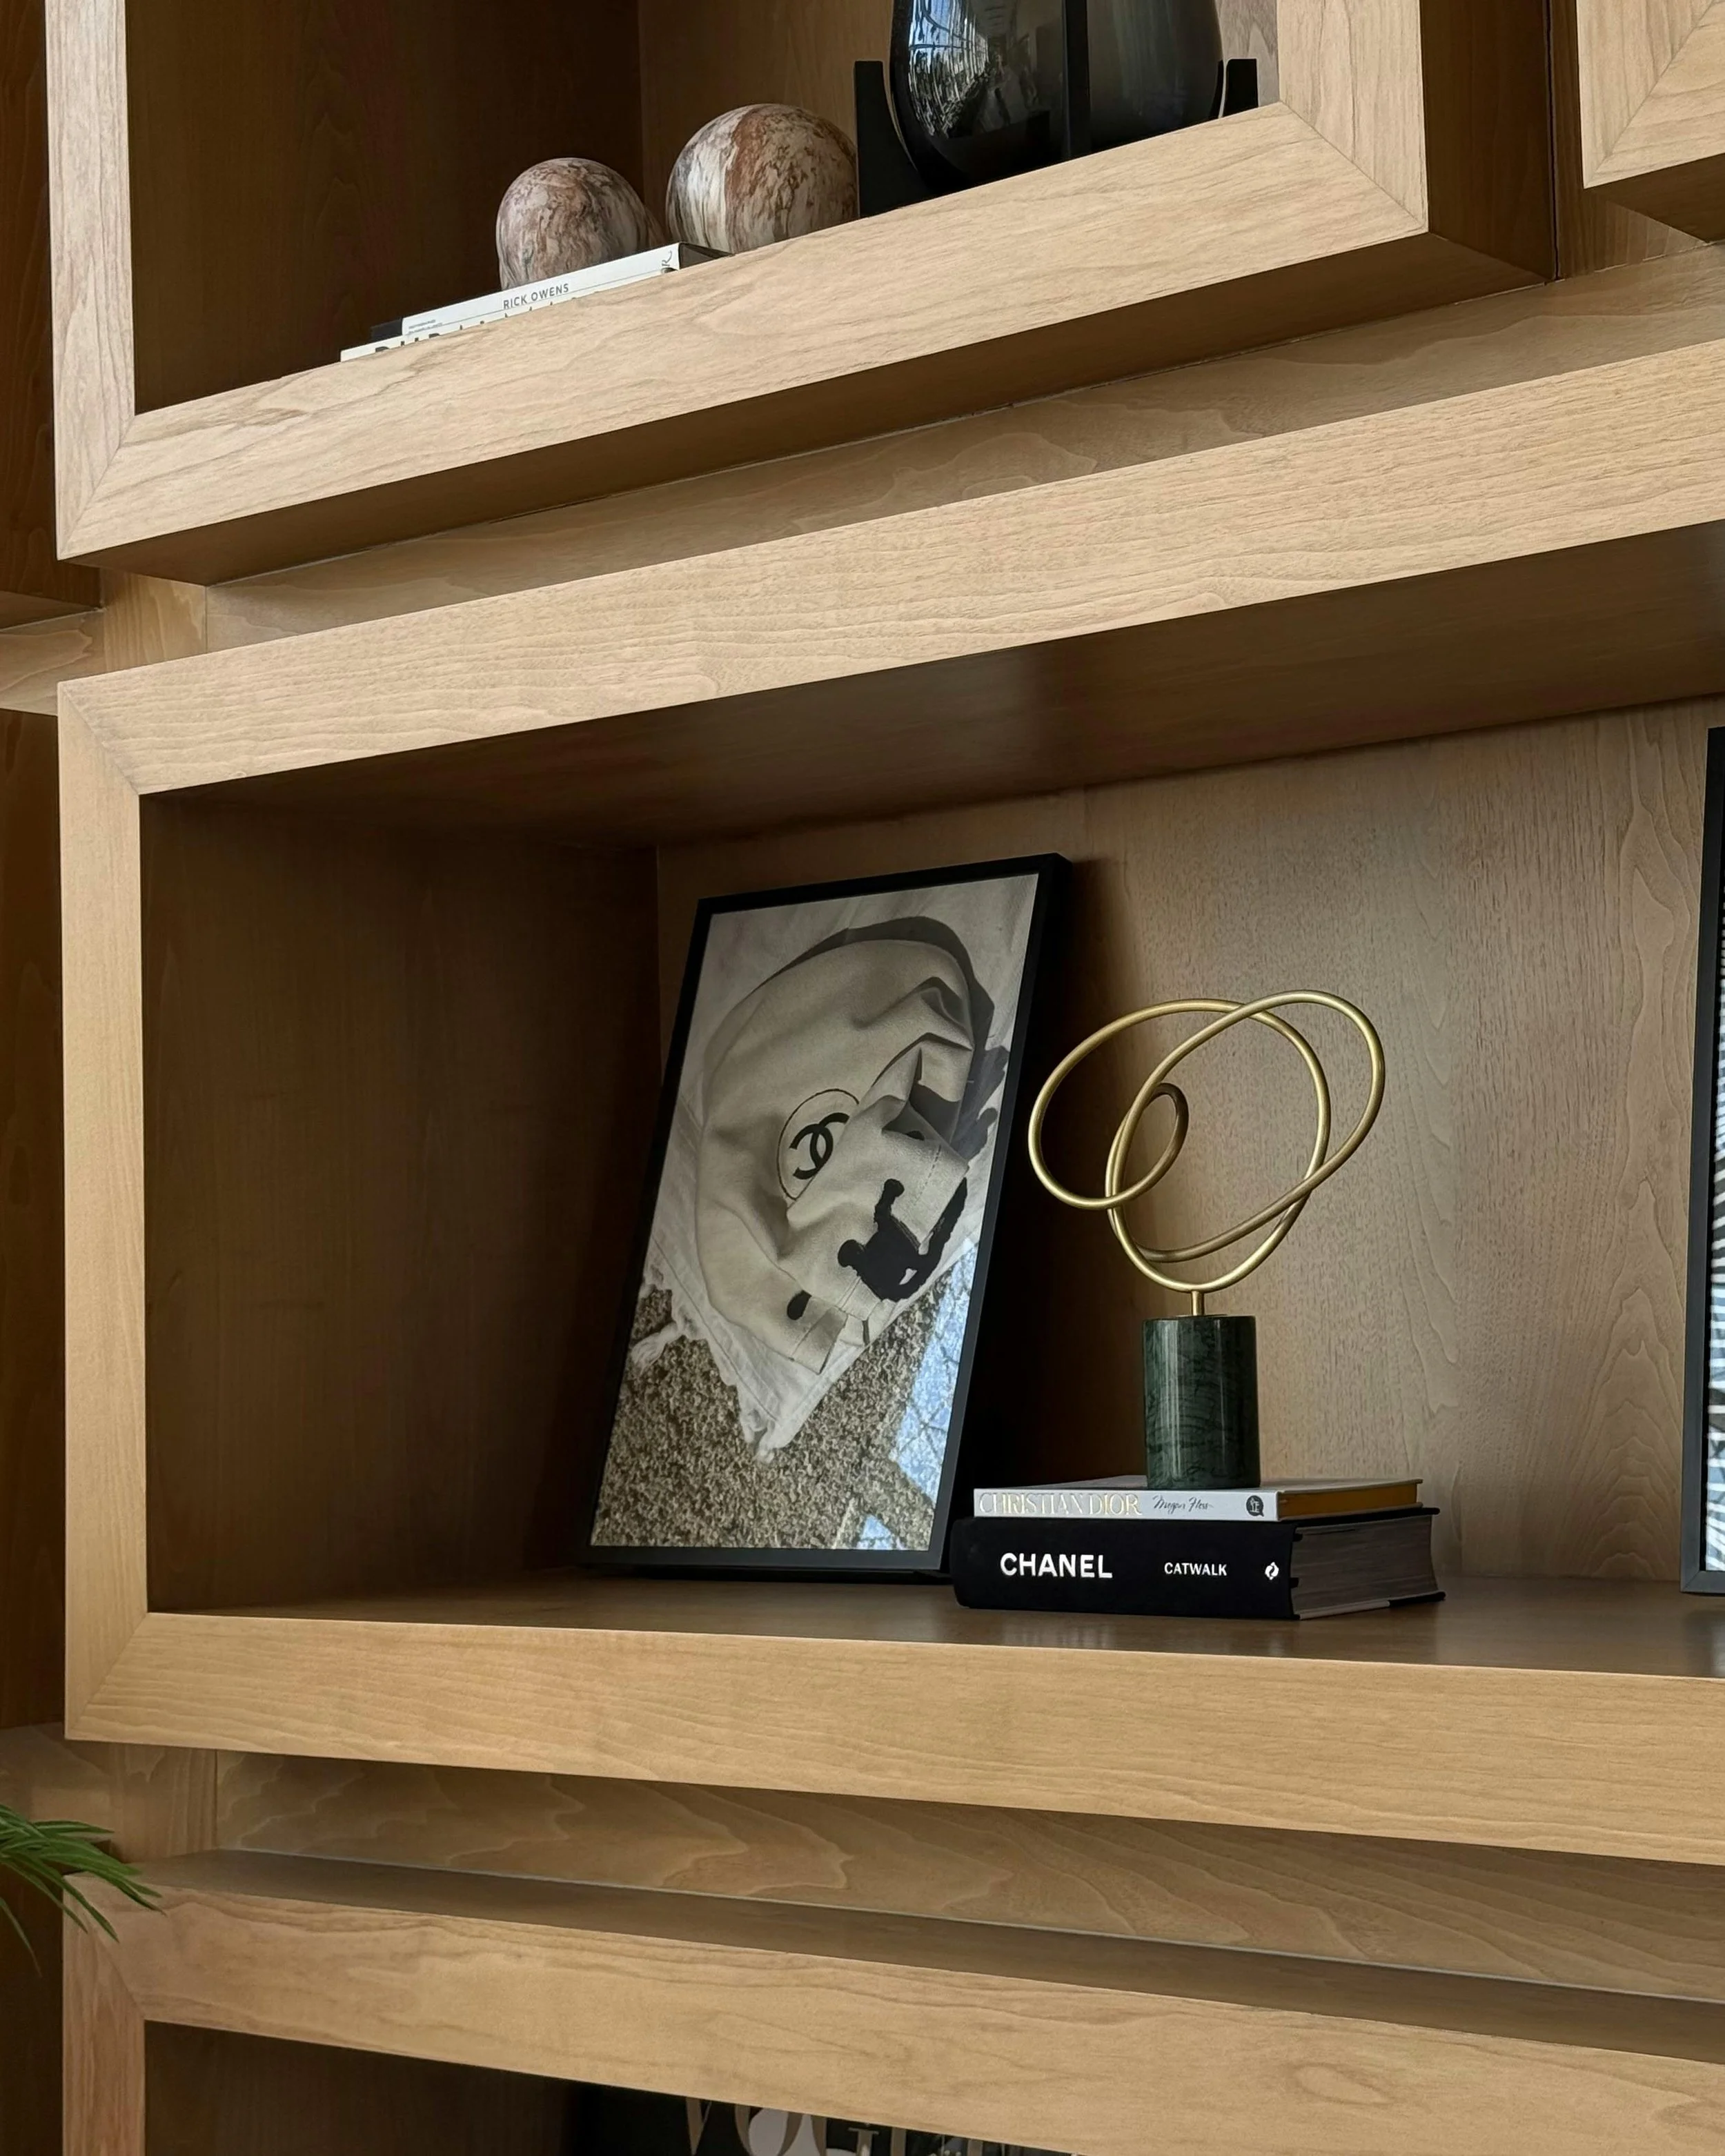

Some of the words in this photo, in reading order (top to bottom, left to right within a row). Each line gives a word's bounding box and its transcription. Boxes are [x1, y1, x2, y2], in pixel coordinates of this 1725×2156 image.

[503, 294, 527, 310] RICK
[531, 283, 569, 301] OWENS
[979, 1492, 1083, 1514] CHRISTIAN
[1088, 1492, 1143, 1516] DIOR
[1000, 1552, 1113, 1579] CHANEL
[1164, 1562, 1228, 1576] CATWALK
